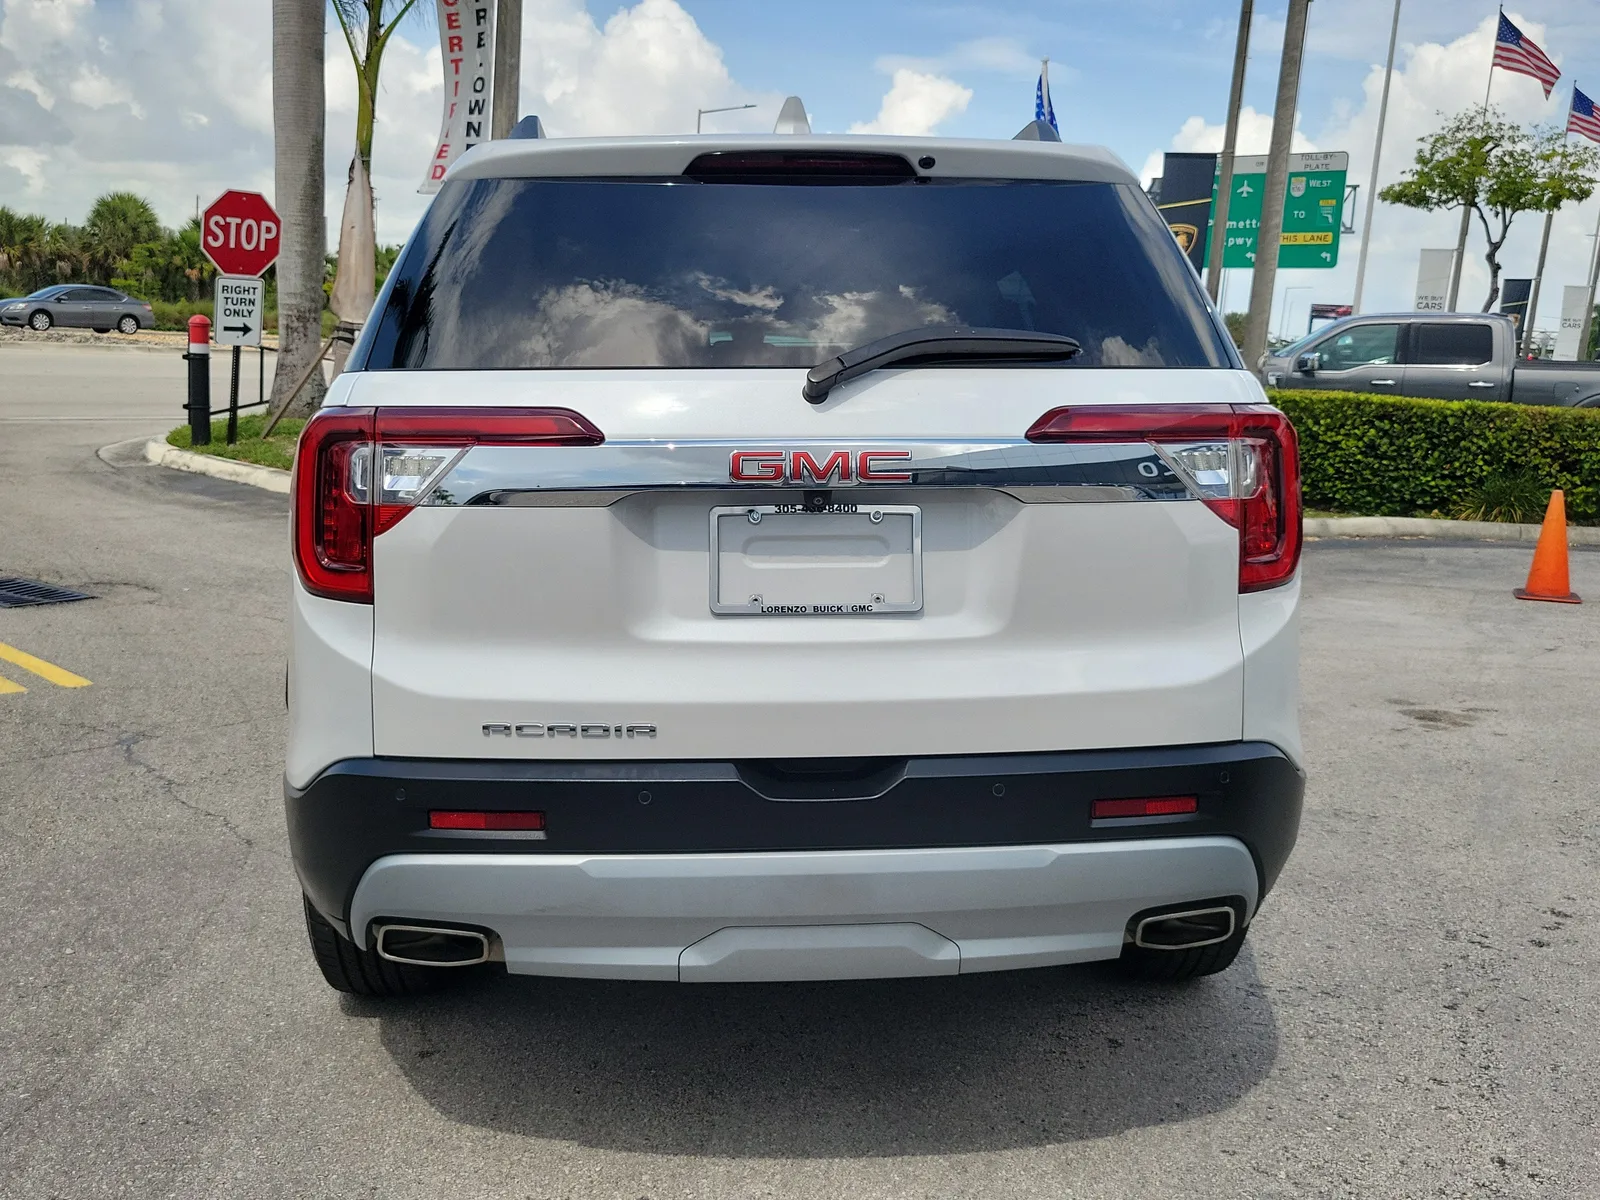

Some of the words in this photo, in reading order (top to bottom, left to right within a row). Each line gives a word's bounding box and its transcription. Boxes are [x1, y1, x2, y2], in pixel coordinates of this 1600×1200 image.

[1309, 180, 1332, 188] WEST
[207, 215, 277, 251] STOP
[1303, 234, 1330, 242] LANE
[221, 285, 258, 296] RIGHT
[224, 297, 255, 307] TURN
[1416, 302, 1443, 311] CARS
[224, 308, 254, 318] ONLY
[730, 450, 912, 484] GMC
[813, 605, 844, 613] BUICK
[482, 722, 657, 738] ACADIA
